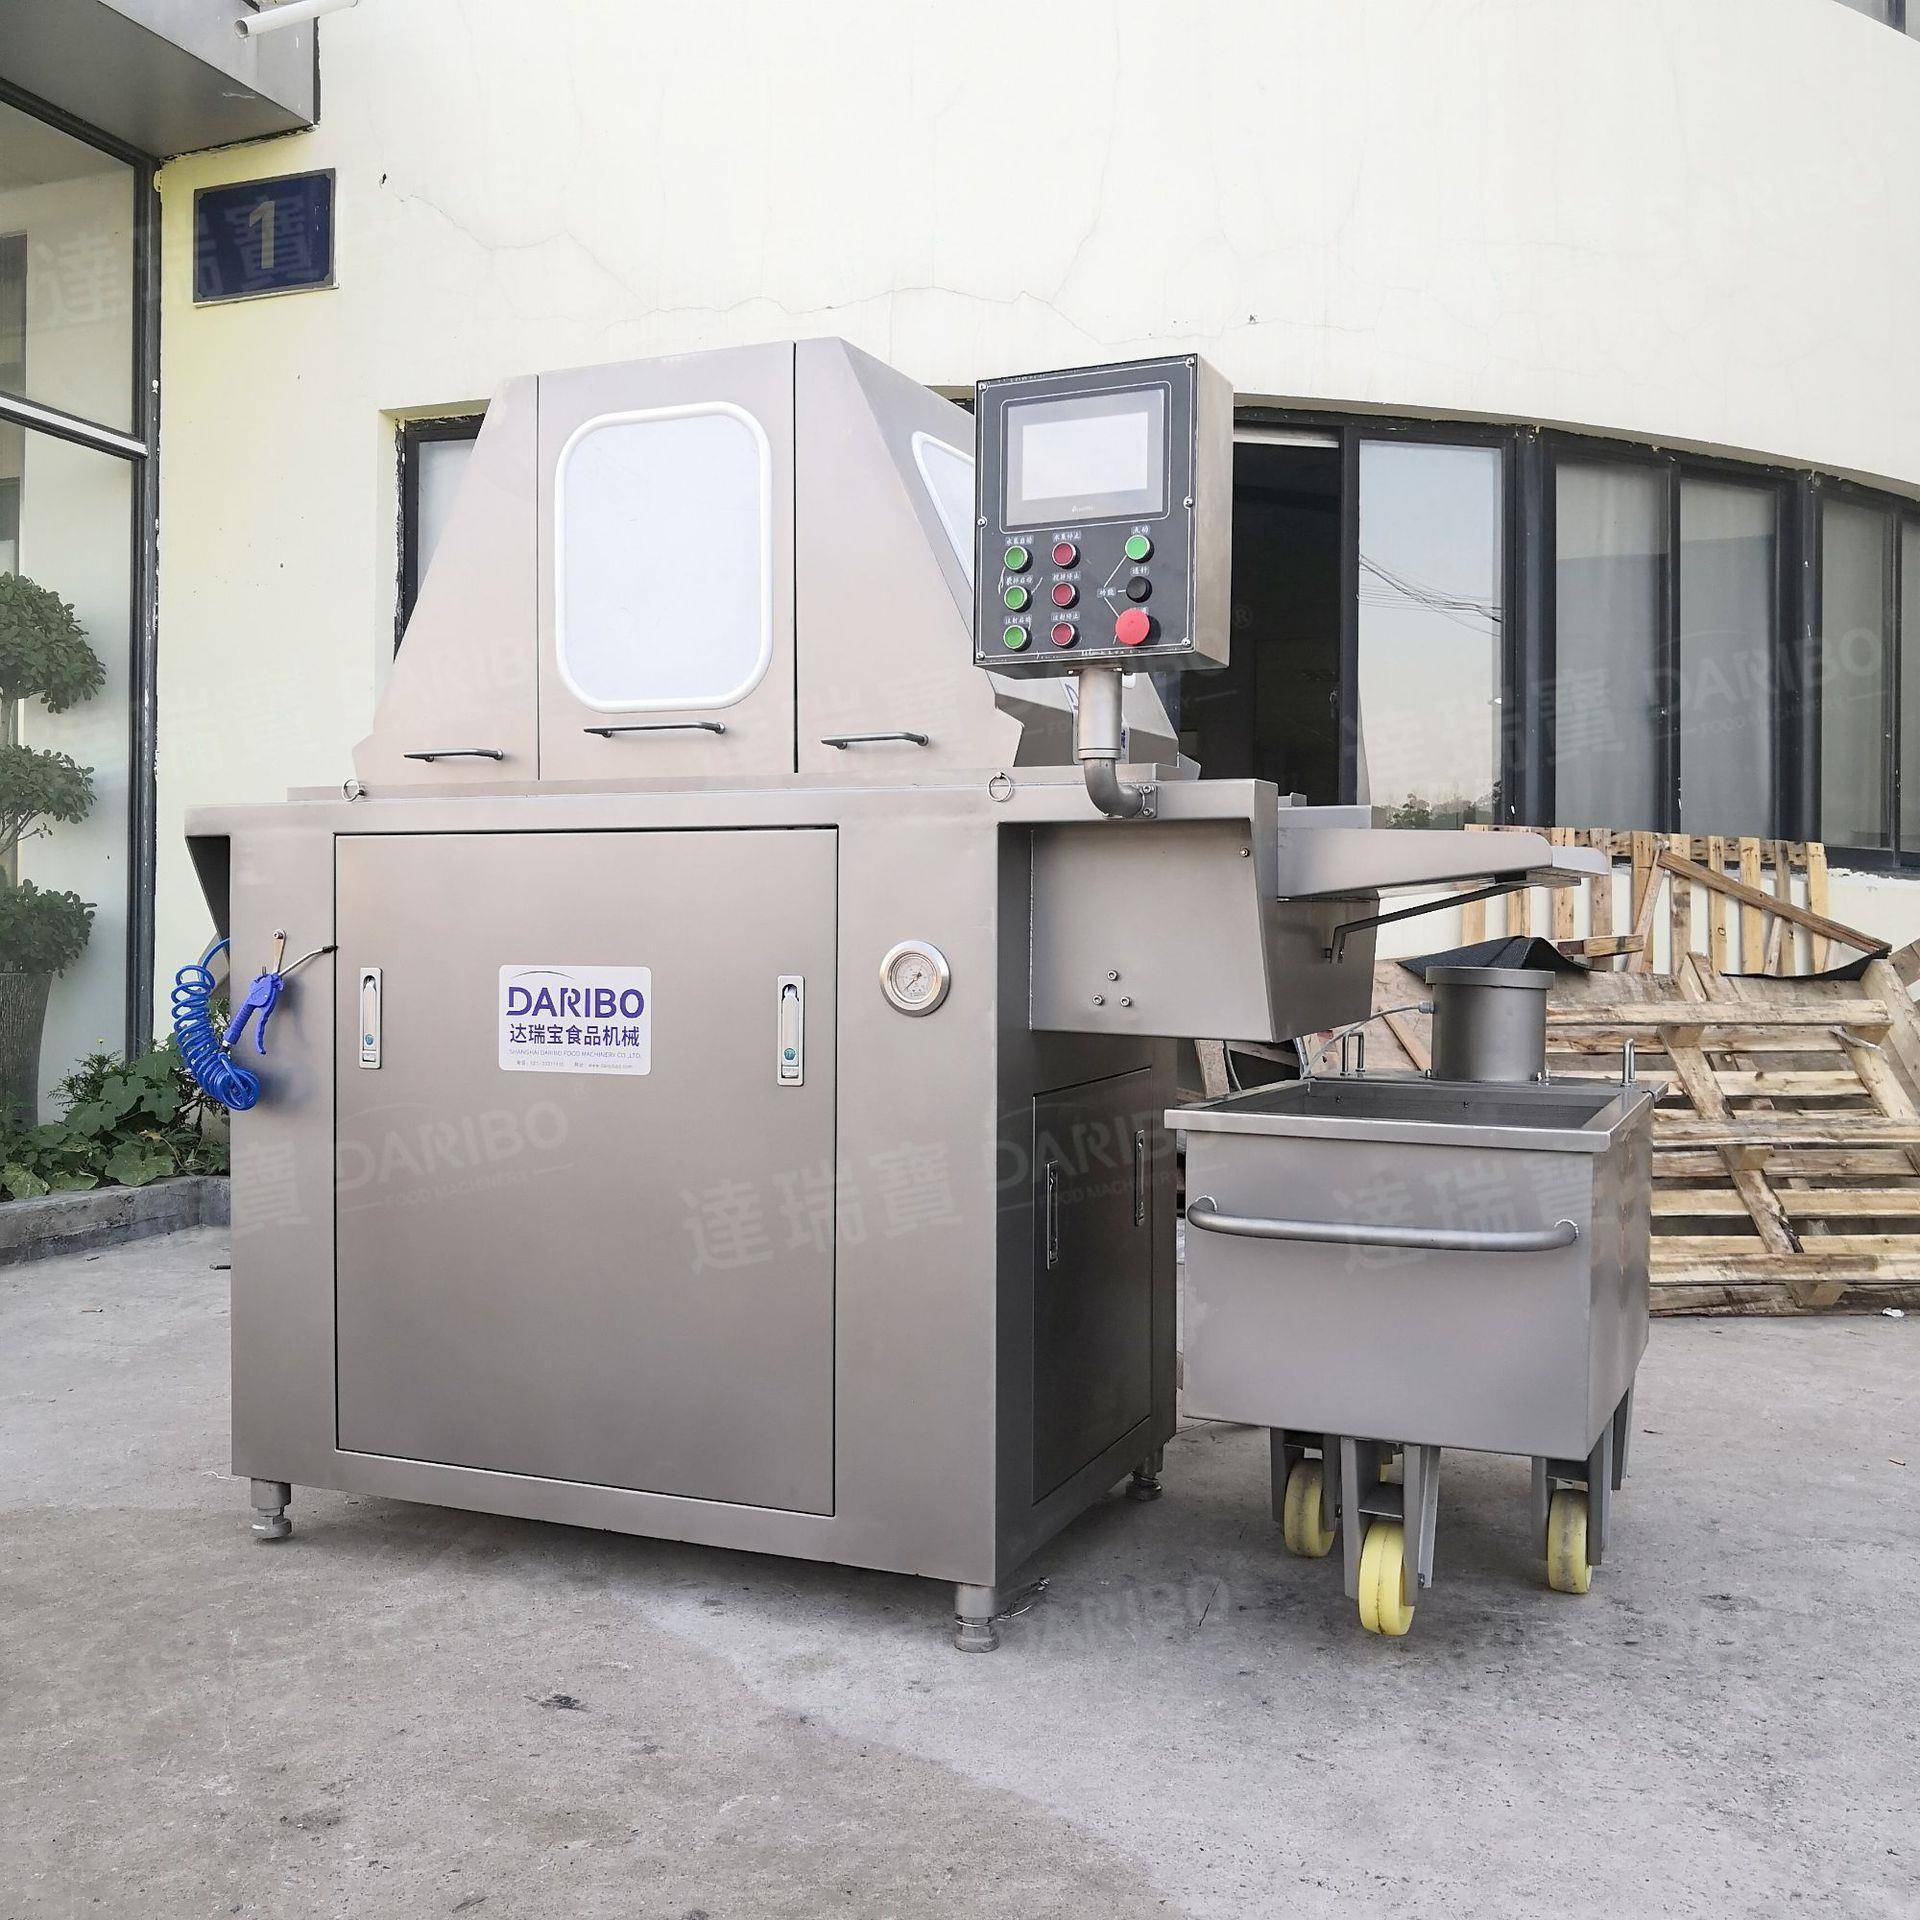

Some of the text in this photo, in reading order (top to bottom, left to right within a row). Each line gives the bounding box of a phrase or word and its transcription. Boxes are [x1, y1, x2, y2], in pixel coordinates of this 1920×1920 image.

[249, 199, 277, 270] 1
[506, 986, 645, 1019] DARIBO
[509, 1023, 640, 1047] 达瑞宝食品机械
